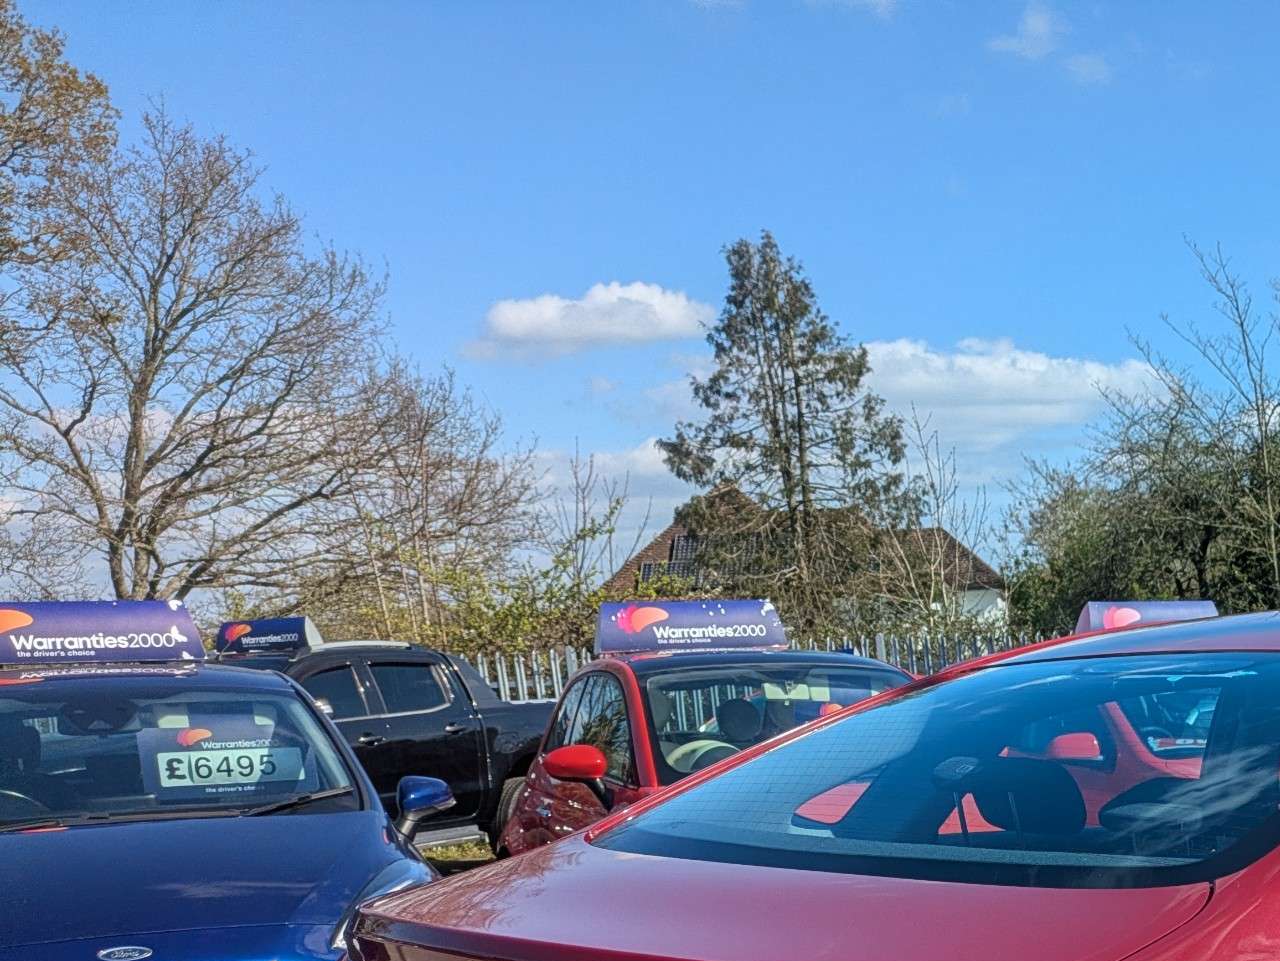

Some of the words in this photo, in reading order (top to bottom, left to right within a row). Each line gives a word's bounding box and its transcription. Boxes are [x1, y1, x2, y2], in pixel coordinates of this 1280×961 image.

[241, 632, 299, 645] Warranties2000
[653, 624, 767, 639] Warranties2000
[10, 632, 177, 650] Warranties2000
[33, 649, 65, 658] driver's
[67, 649, 96, 657] choice
